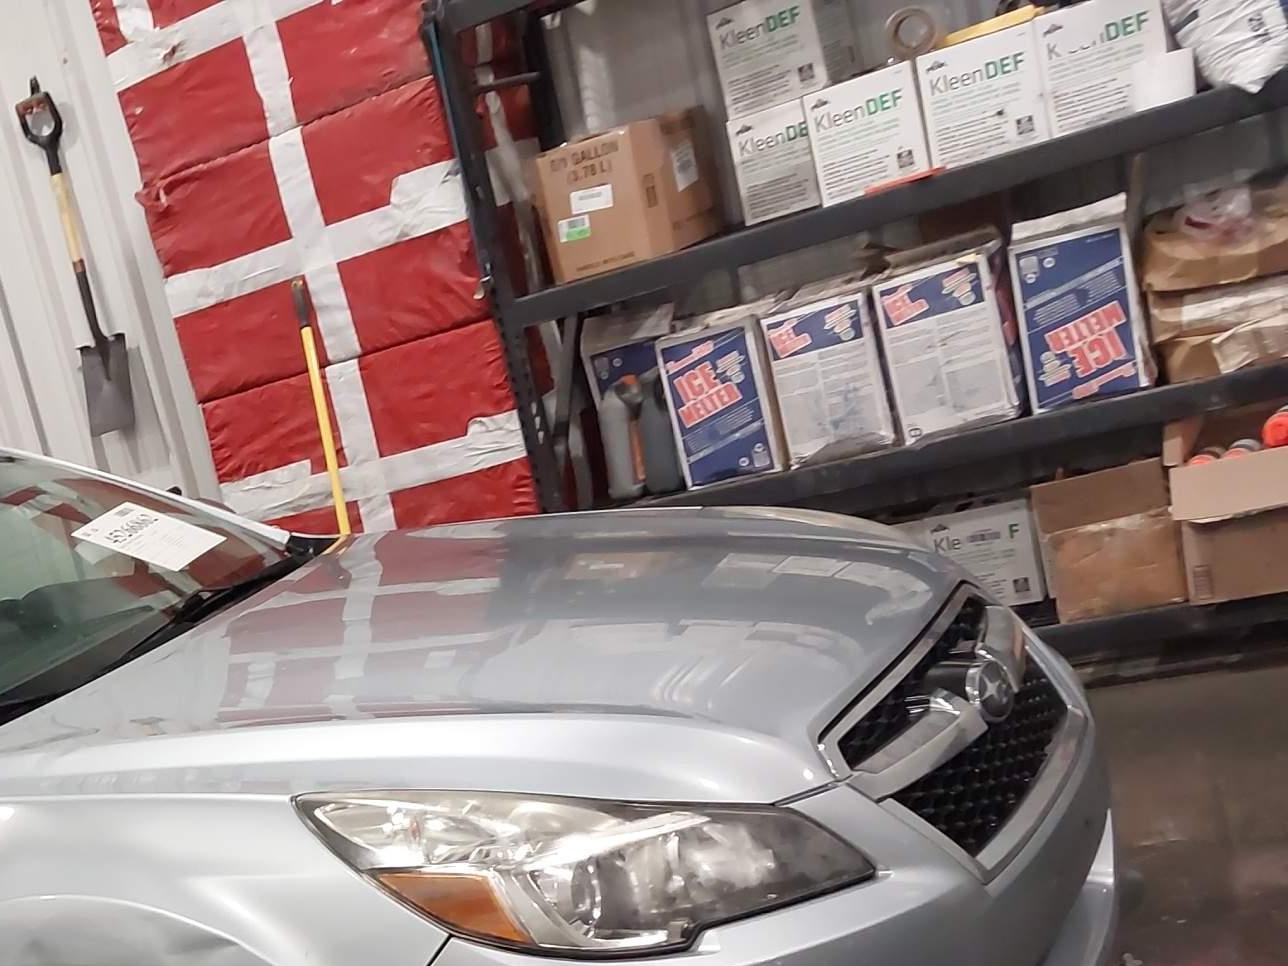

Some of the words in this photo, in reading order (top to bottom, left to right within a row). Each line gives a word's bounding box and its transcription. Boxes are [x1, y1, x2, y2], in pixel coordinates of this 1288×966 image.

[718, 5, 801, 49] KleenDEF
[1046, 10, 1149, 60] KDEF
[928, 51, 1025, 96] KleenDEF
[813, 88, 903, 133] KleenDEF
[738, 120, 808, 157] KleenDE
[1044, 300, 1127, 354] MELTER
[1067, 328, 1127, 378] ICE
[673, 361, 721, 404] ICE
[678, 382, 743, 428] MELTER
[934, 523, 1019, 552] KleF
